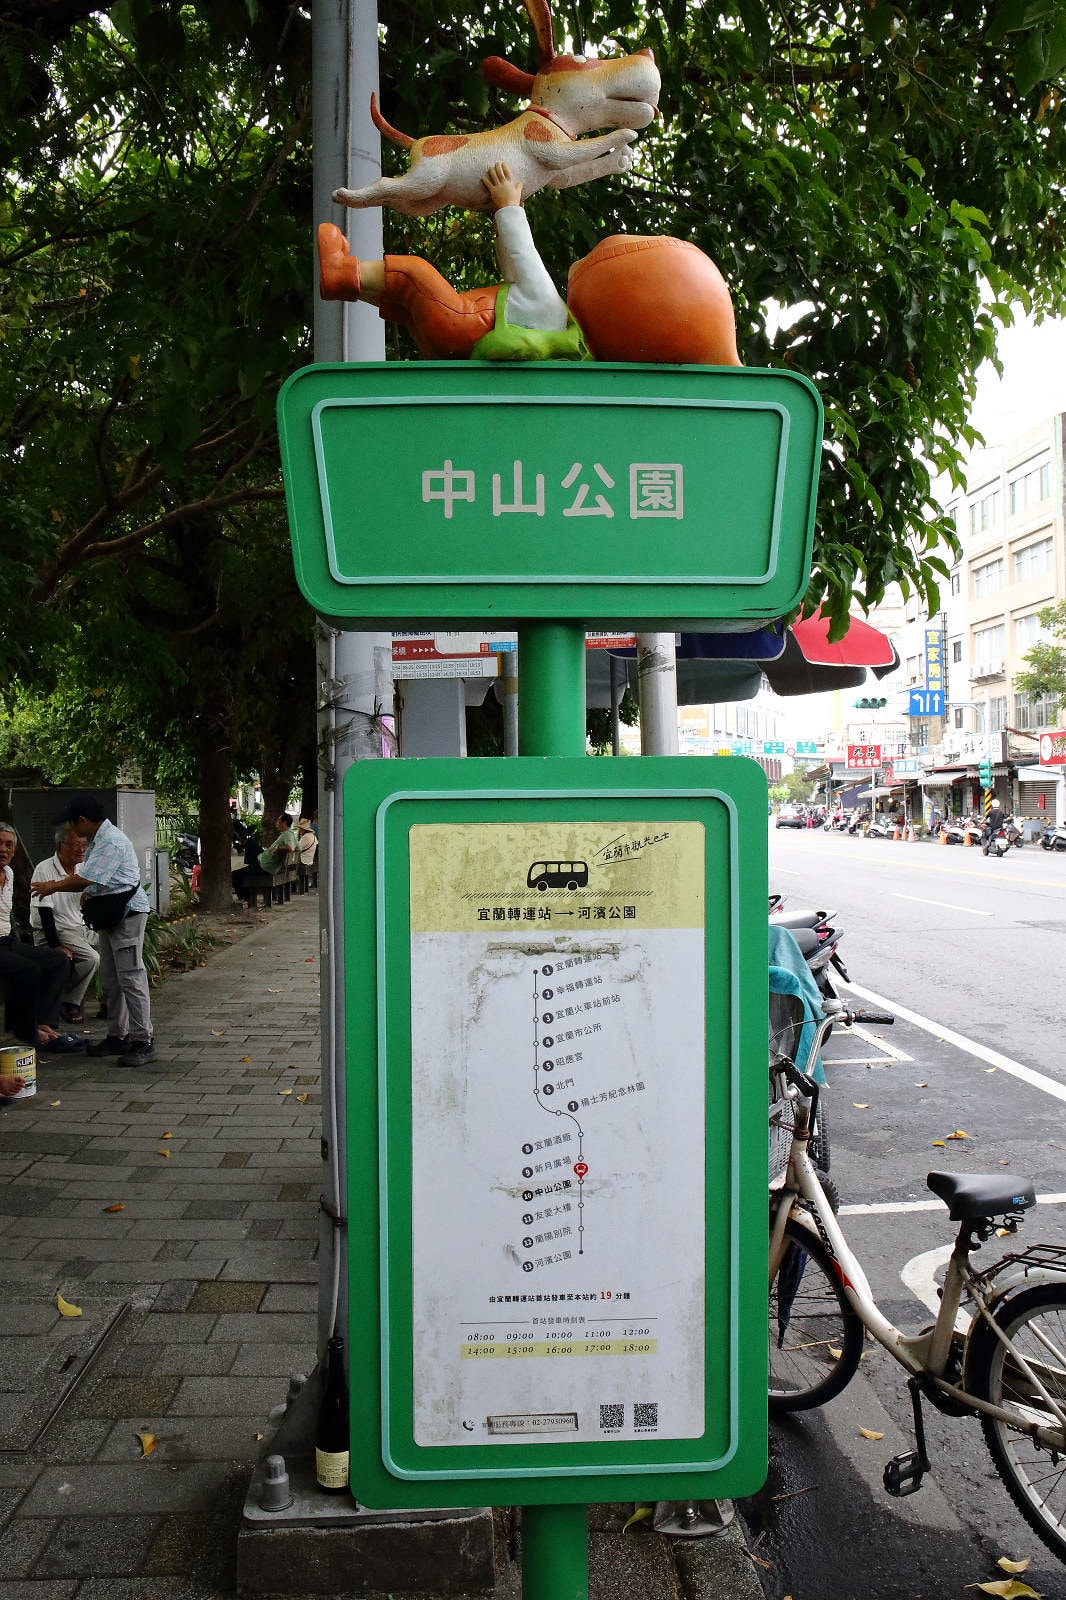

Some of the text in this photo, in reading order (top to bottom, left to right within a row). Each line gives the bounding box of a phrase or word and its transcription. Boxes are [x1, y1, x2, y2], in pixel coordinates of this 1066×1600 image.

[421, 459, 684, 520] 中山公園
[603, 832, 670, 860] 宜蘭市觀光巴士
[477, 905, 637, 921] 宜蘭轉運站 河濱公園
[555, 953, 602, 972] 宜蘭轉運站
[556, 976, 603, 995] 幸福轉運站
[555, 993, 621, 1020] 宜蘭火車站前站
[555, 1022, 602, 1043] 宜蘭市公所
[556, 1078, 575, 1091] 北門
[534, 1132, 572, 1151] 宜蘭酒廠
[534, 1155, 572, 1174] 新月廣場
[534, 1180, 572, 1197] 中山公園
[534, 1226, 573, 1244] 蘭陽別院
[534, 1250, 572, 1268] 河濱公園
[600, 1291, 612, 1300] 19
[615, 1292, 631, 1300] 分鐘
[532, 1316, 586, 1326] 首站發車時刻表
[467, 1328, 650, 1341] 08:00 09:00 10:00 11:00 12:00
[468, 1343, 650, 1356] 14:00 15:00 16:00 17:00 18:00
